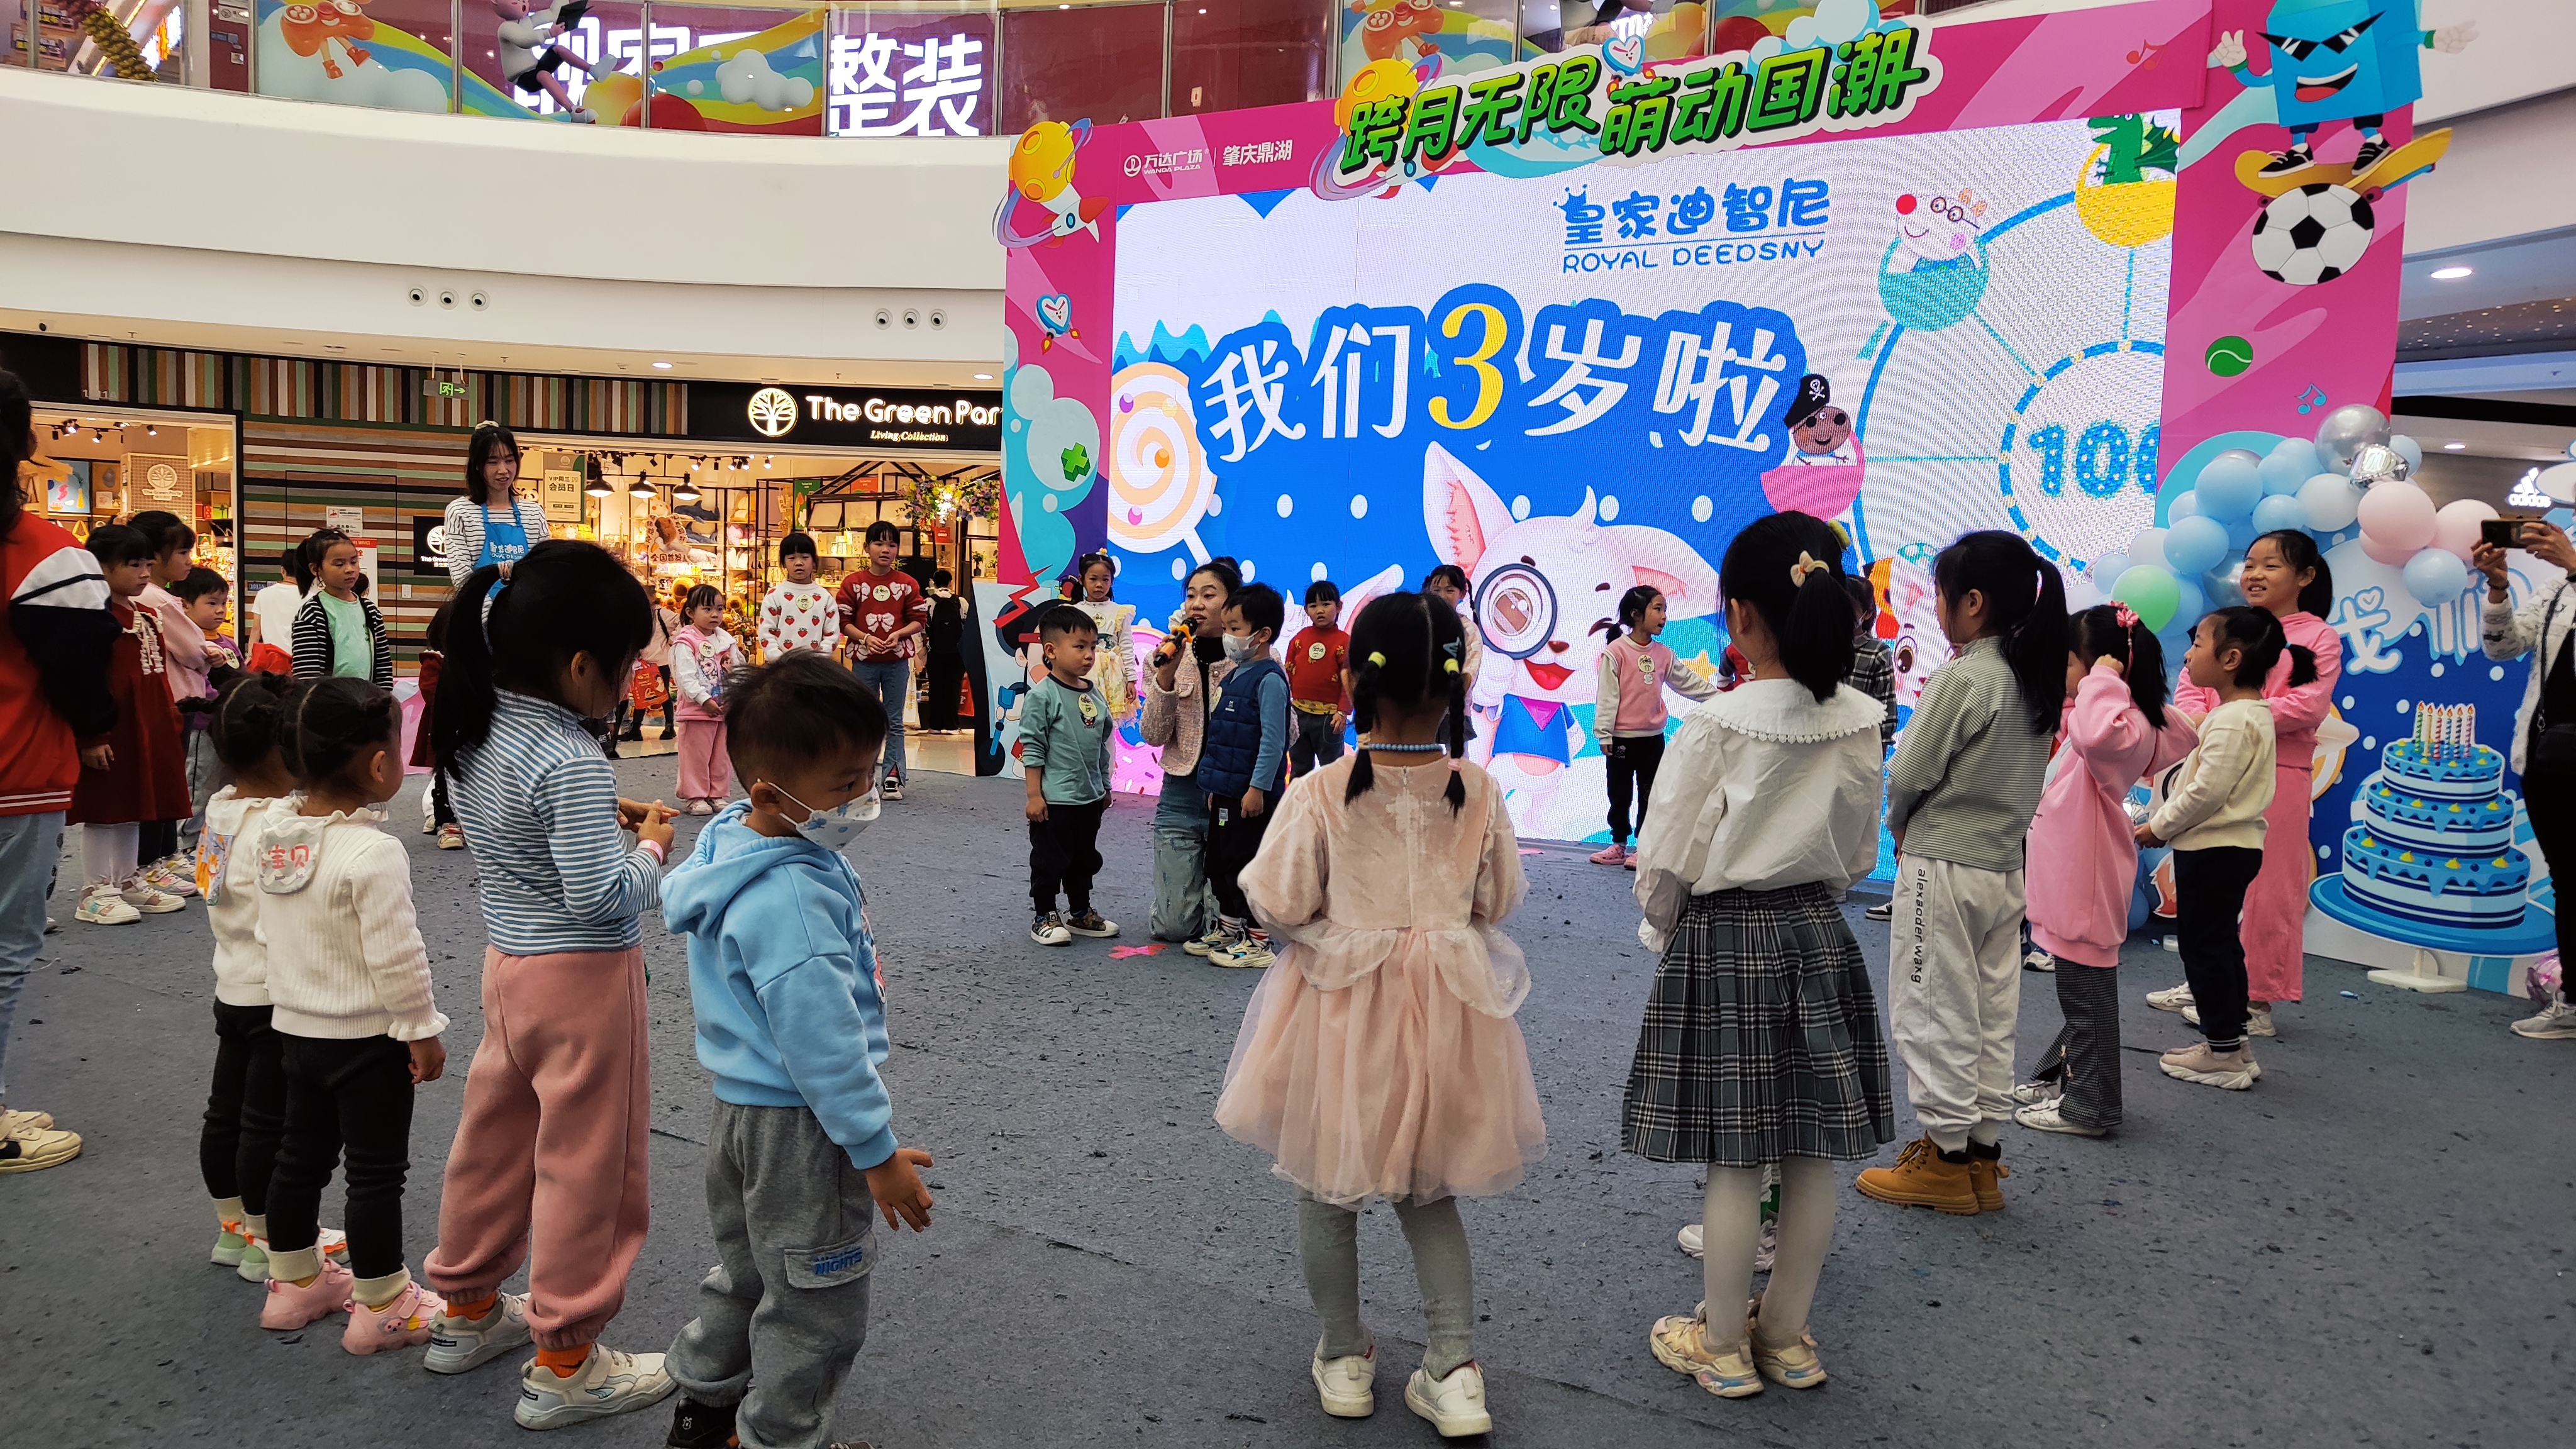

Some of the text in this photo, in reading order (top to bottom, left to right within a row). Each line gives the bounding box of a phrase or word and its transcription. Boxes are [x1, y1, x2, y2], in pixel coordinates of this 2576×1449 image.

[830, 32, 983, 137] 整装
[1340, 28, 1929, 174] 跨月无限 萌动国潮
[1144, 140, 1292, 168] 万达广场 肇庆鼎湖
[1553, 178, 1829, 245] 皇家迪智尼
[1563, 238, 1824, 274] ROYAL DEEDSNY
[1201, 303, 1787, 463] 我们3岁啦
[806, 396, 862, 422] The
[864, 398, 952, 425] Green
[870, 430, 948, 441] Living Collection
[548, 482, 574, 492] 会员日
[2508, 492, 2551, 508] adidas
